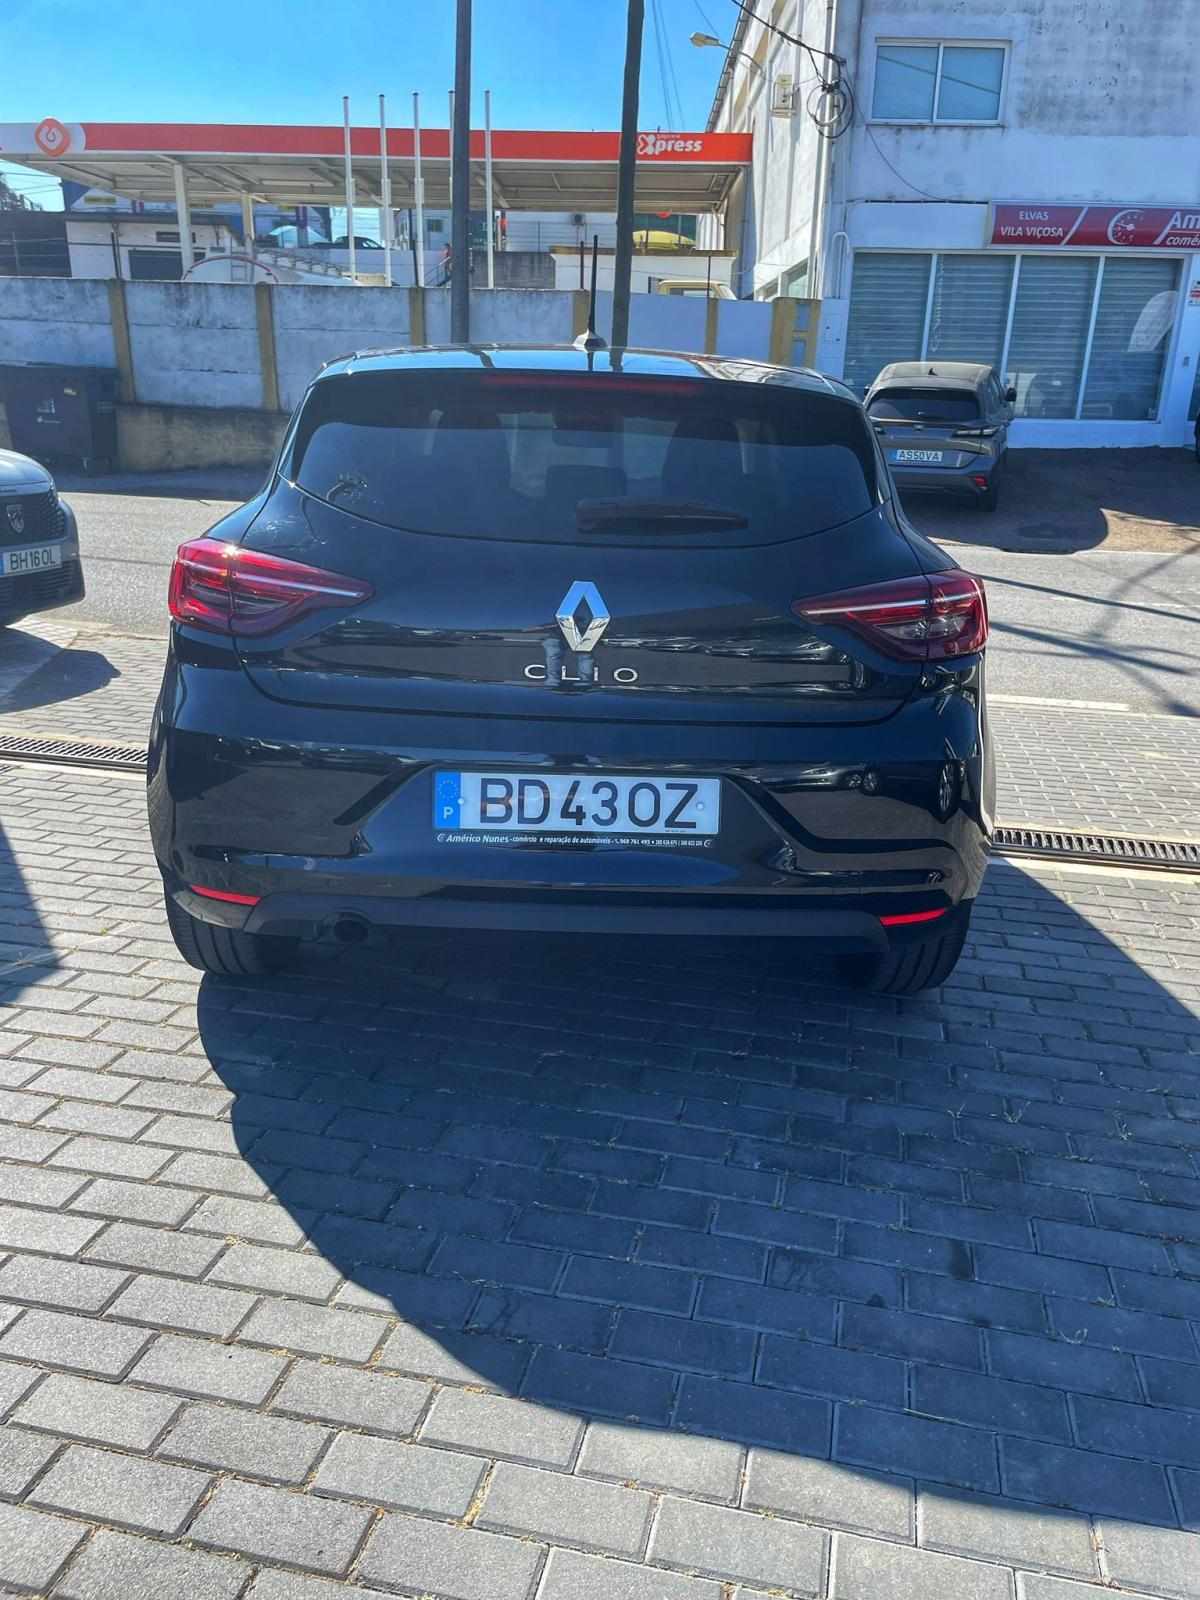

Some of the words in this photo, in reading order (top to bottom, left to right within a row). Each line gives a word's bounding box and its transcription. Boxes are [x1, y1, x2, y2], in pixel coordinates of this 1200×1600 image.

[1018, 210, 1049, 221] ELVAS
[1000, 225, 1024, 237] VILA
[1026, 226, 1064, 239] VIÇOSA
[1166, 232, 1200, 246] comé
[523, 664, 639, 683] CLIO
[443, 806, 453, 819] P
[446, 832, 481, 843] Américo
[482, 834, 509, 844] Nunes
